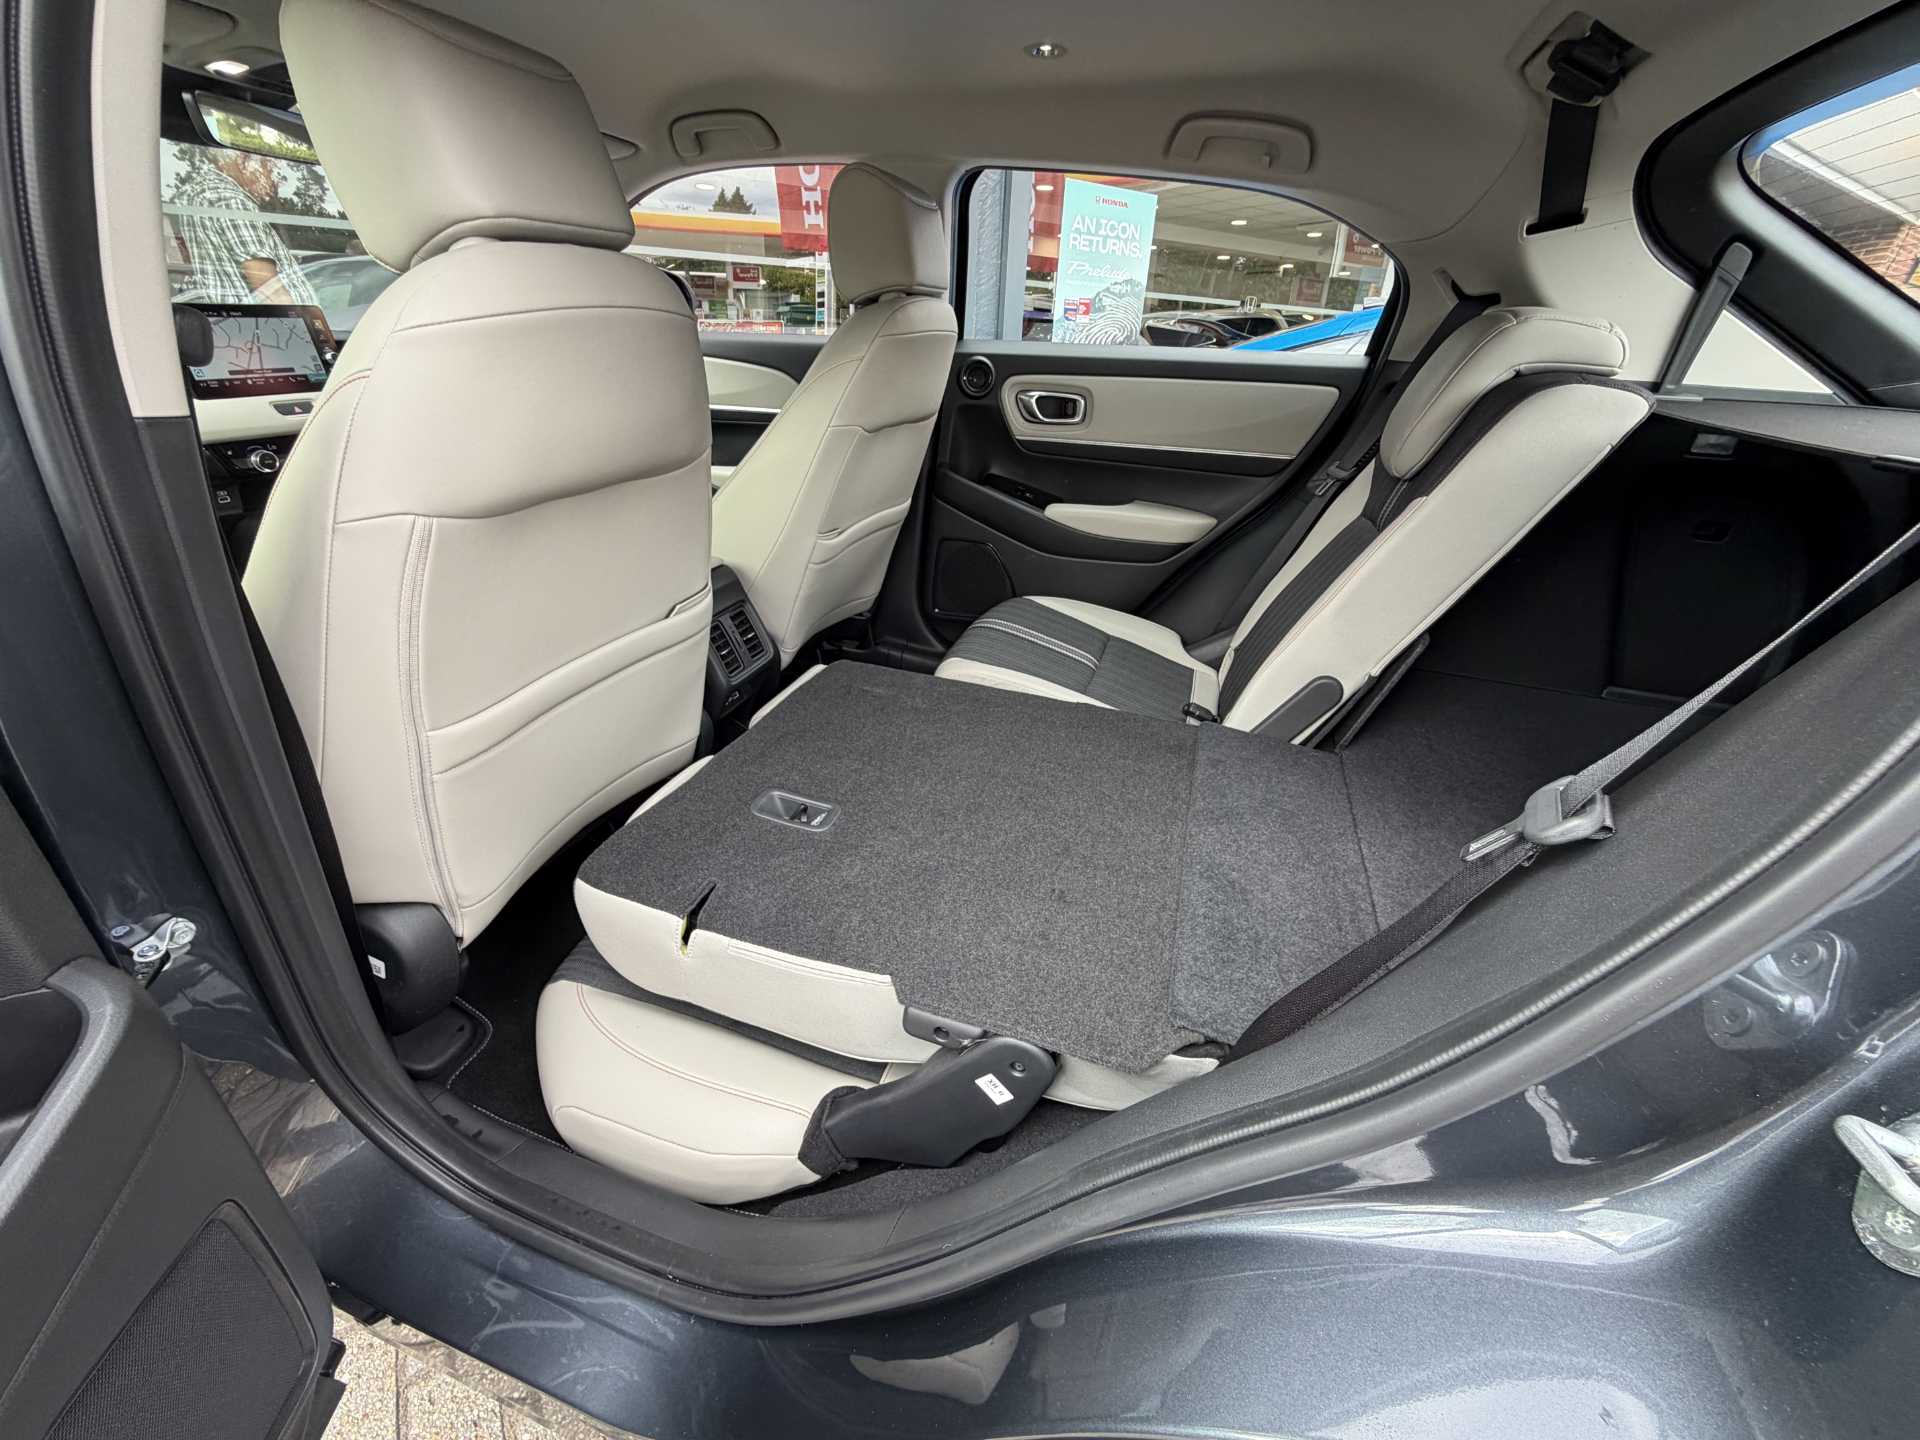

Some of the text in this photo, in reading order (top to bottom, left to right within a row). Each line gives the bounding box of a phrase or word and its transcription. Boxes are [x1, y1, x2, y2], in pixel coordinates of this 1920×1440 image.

[1102, 197, 1128, 208] HONDA
[1072, 214, 1141, 240] AN ICON
